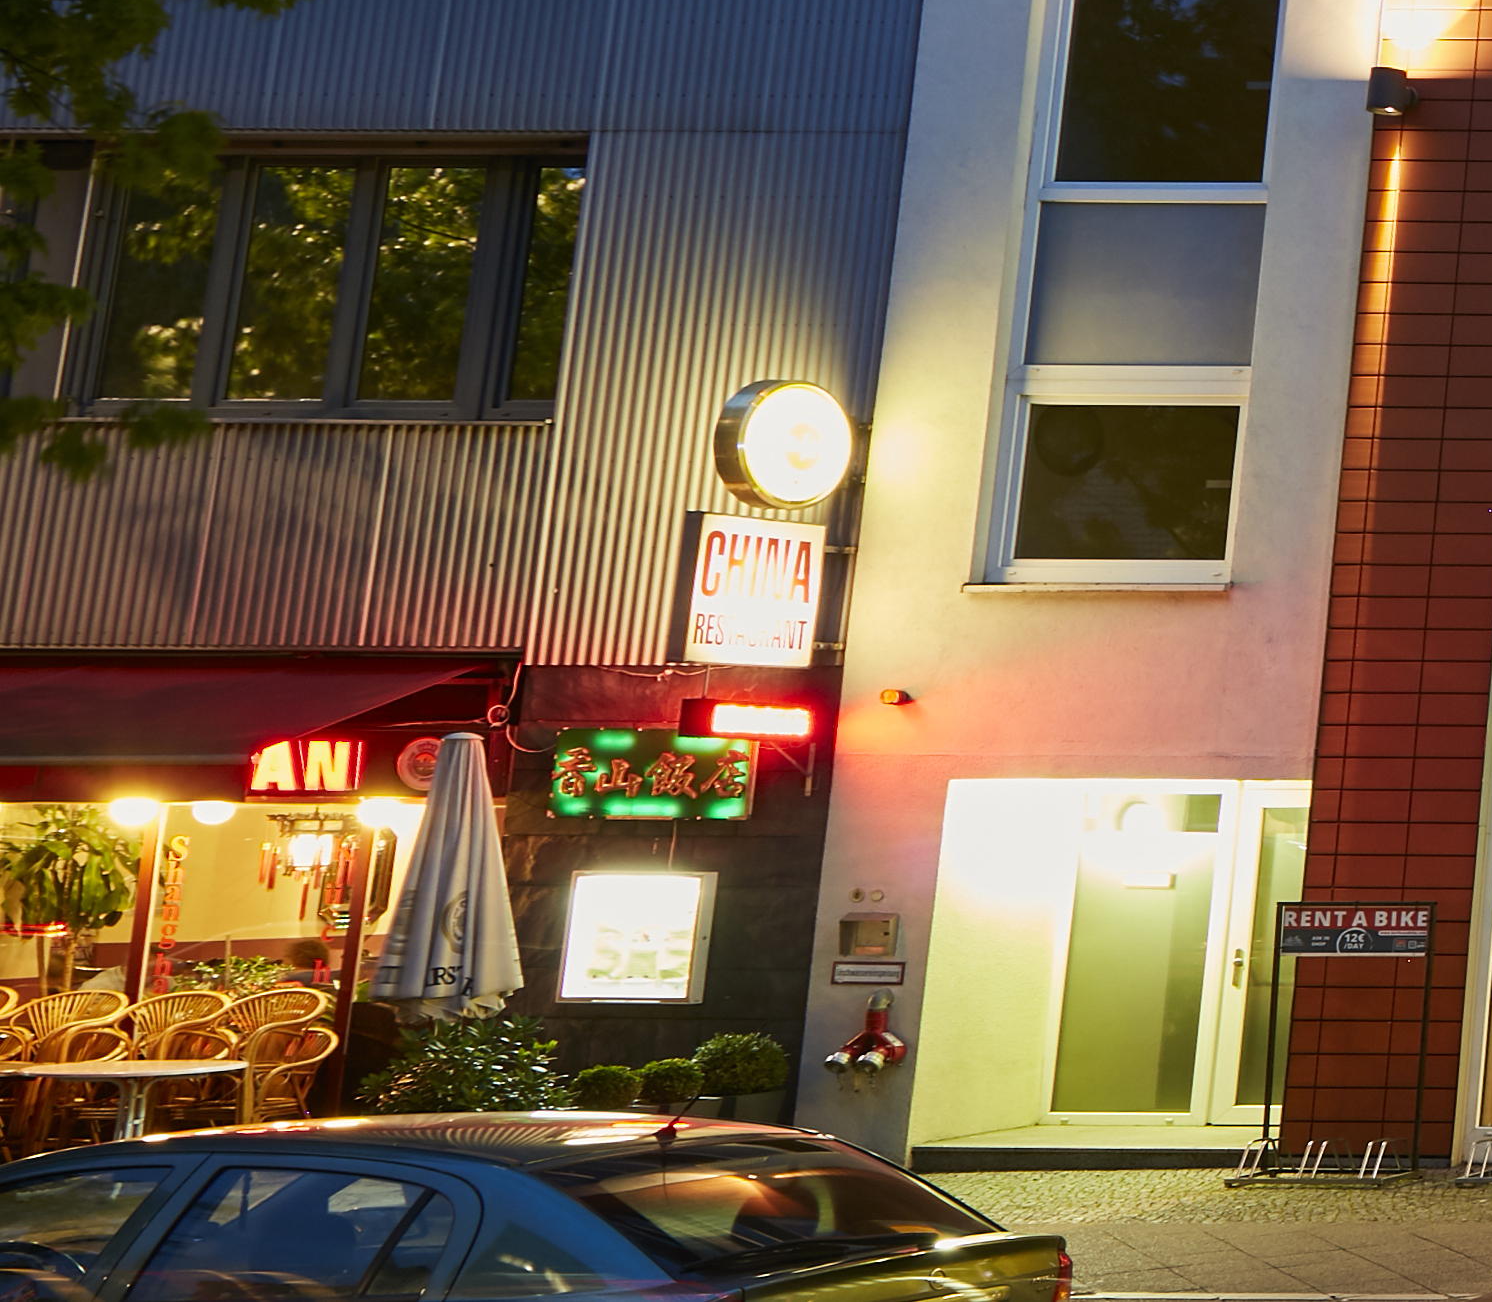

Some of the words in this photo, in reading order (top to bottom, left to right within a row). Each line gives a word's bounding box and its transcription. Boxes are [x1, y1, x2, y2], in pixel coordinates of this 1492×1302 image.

[701, 530, 811, 604] CHINA
[693, 613, 807, 650] RESTAANT
[552, 747, 750, 799] 香山飯店
[1284, 911, 1347, 927] RENT
[1351, 911, 1368, 927] A
[1374, 911, 1428, 927] BIKE
[1344, 933, 1365, 942] 12€
